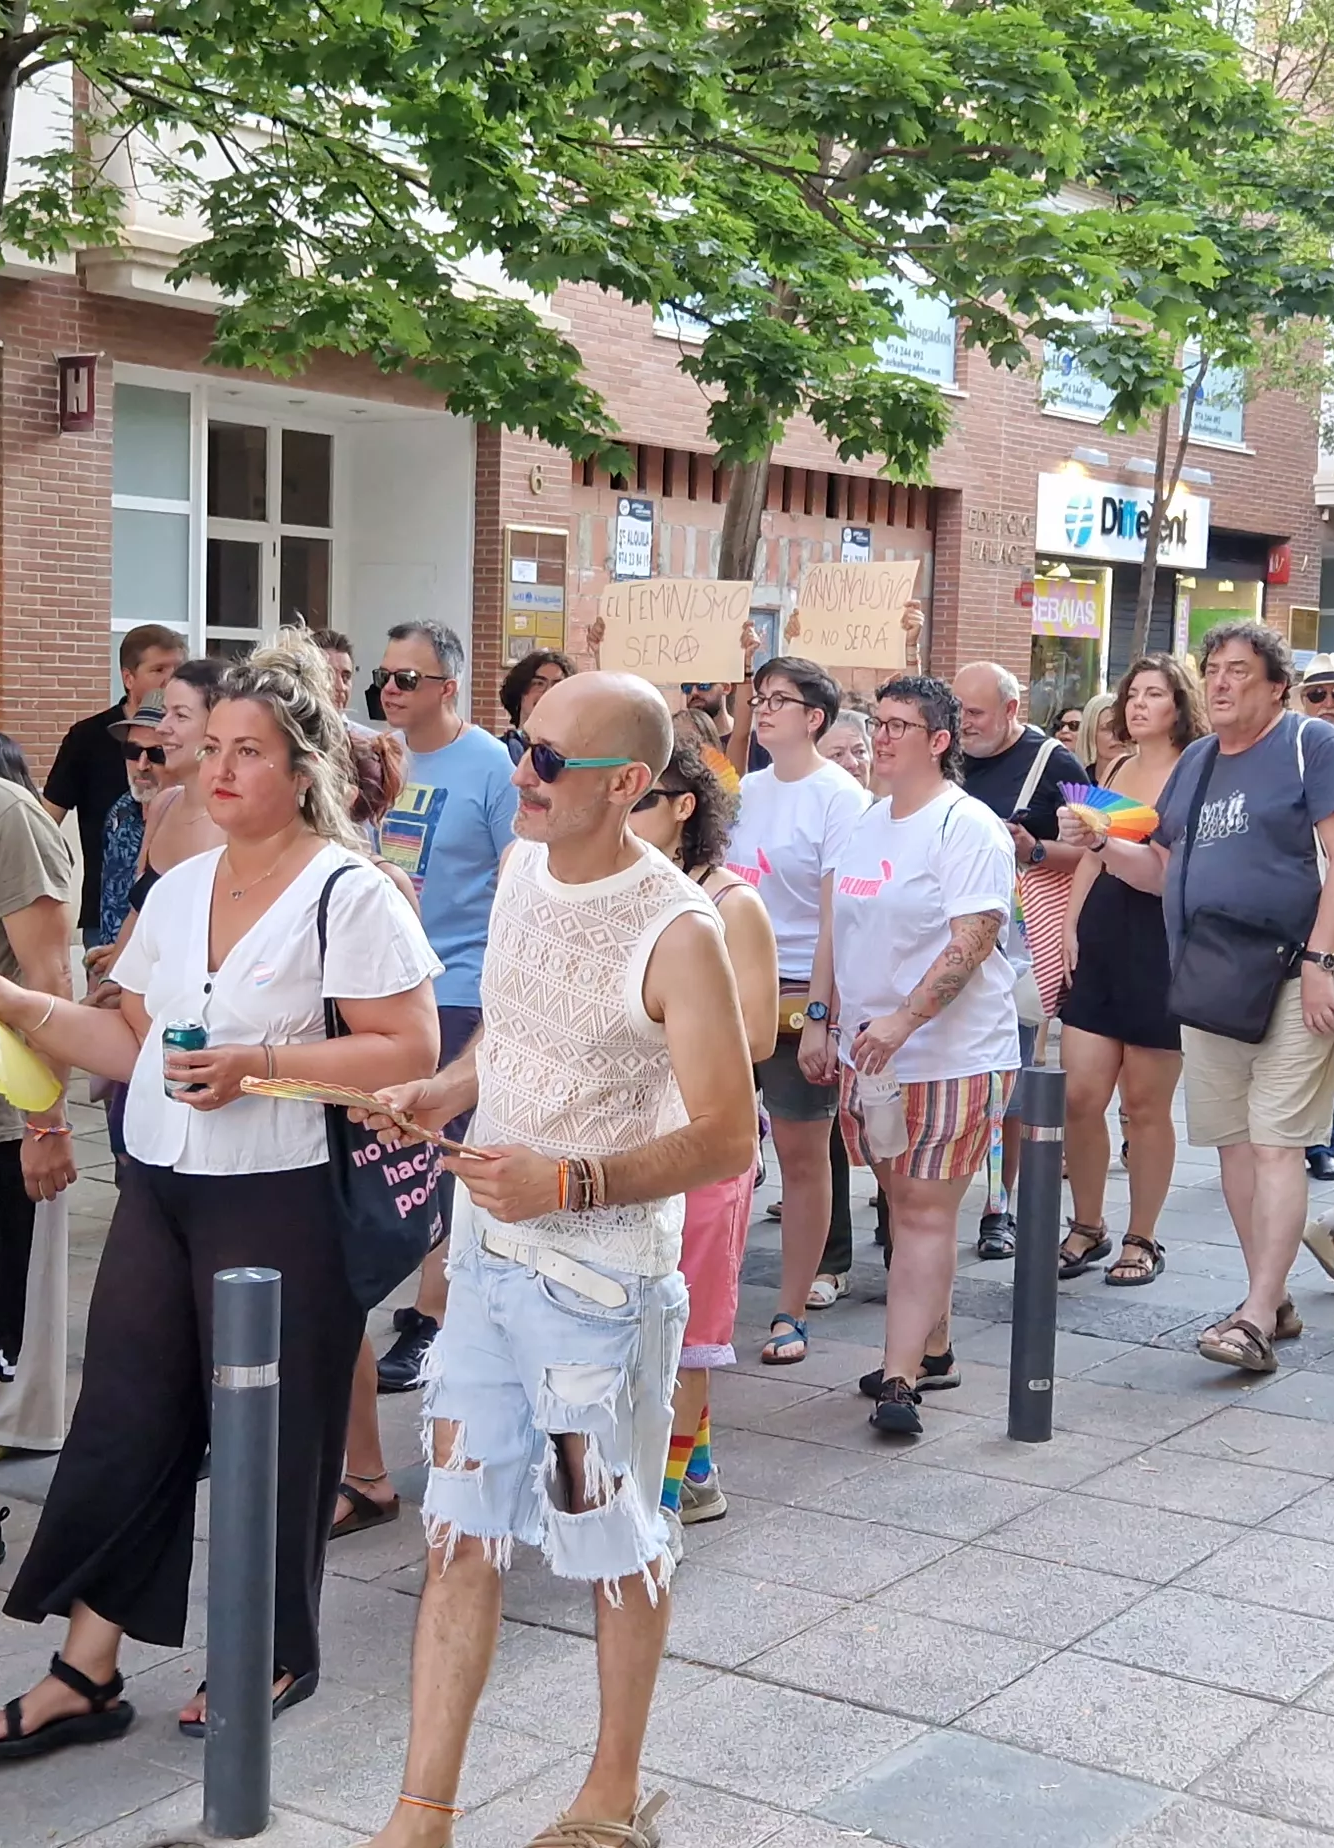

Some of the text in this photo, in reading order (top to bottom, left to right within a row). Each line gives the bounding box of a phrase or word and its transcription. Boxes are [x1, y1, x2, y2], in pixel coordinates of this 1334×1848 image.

[530, 464, 543, 495] 6
[968, 509, 1030, 537] EDIFICIO
[1101, 496, 1188, 546] Diffeent
[970, 541, 1026, 566] PALACE
[820, 629, 839, 646] NO
[845, 621, 890, 651] SERÁ
[352, 1143, 381, 1167] no
